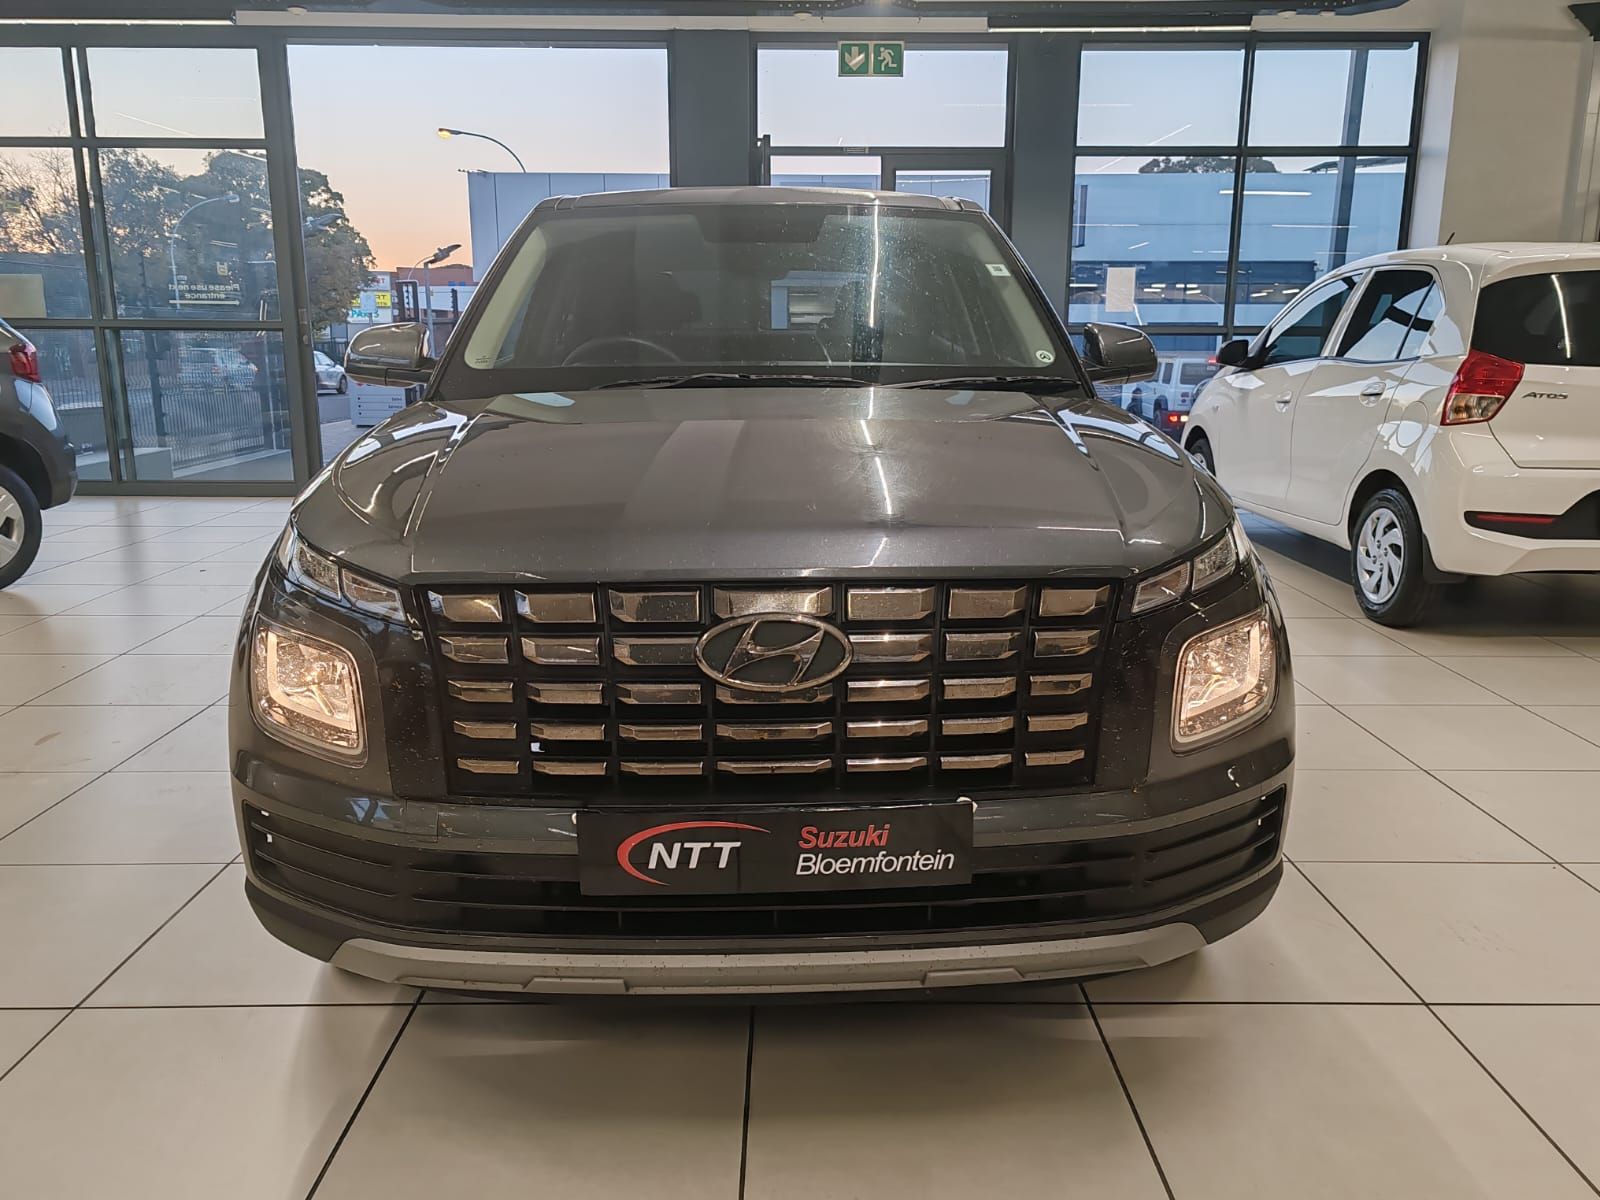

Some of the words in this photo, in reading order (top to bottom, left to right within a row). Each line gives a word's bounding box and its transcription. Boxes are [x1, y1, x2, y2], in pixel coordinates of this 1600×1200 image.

[1521, 391, 1569, 400] ATOS
[797, 823, 891, 849] Suzuki
[647, 841, 742, 870] NTT
[795, 848, 955, 876] Bloemfontein
